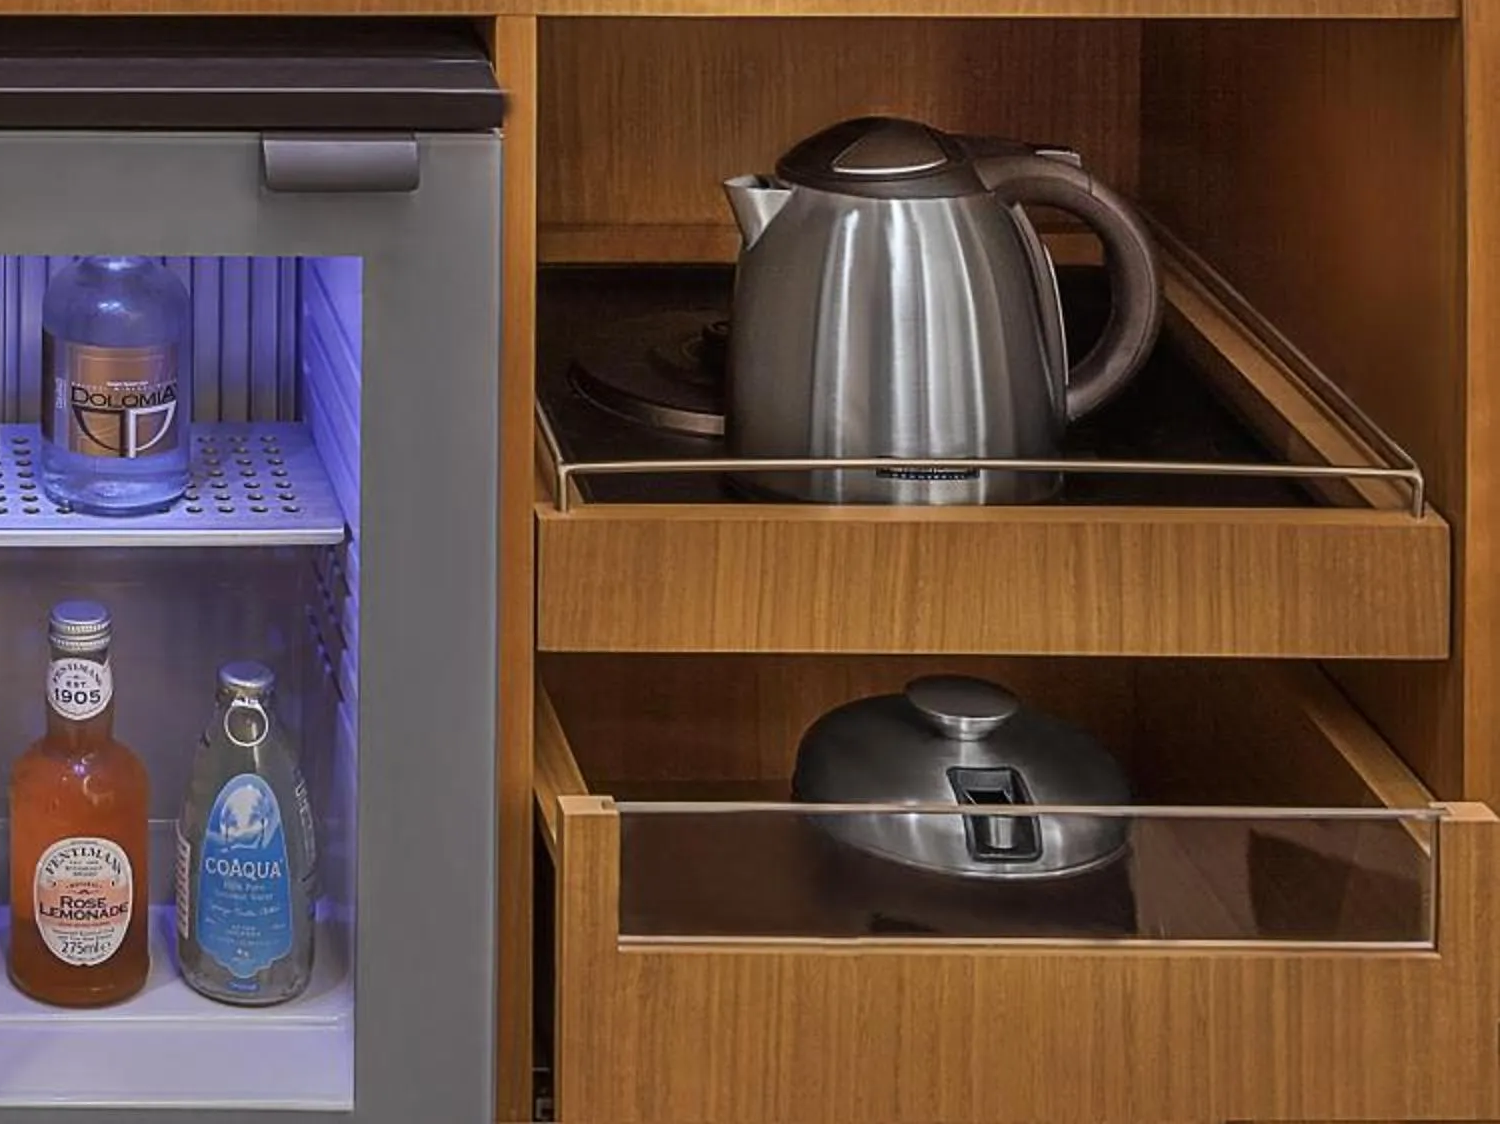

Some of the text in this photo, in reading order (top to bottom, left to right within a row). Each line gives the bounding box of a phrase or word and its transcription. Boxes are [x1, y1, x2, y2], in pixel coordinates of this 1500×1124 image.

[72, 384, 178, 408] DOLOMIA
[55, 688, 101, 705] 1905
[205, 857, 282, 881] COAQUA
[40, 901, 129, 921] LEMONADE
[60, 895, 107, 909] ROSE
